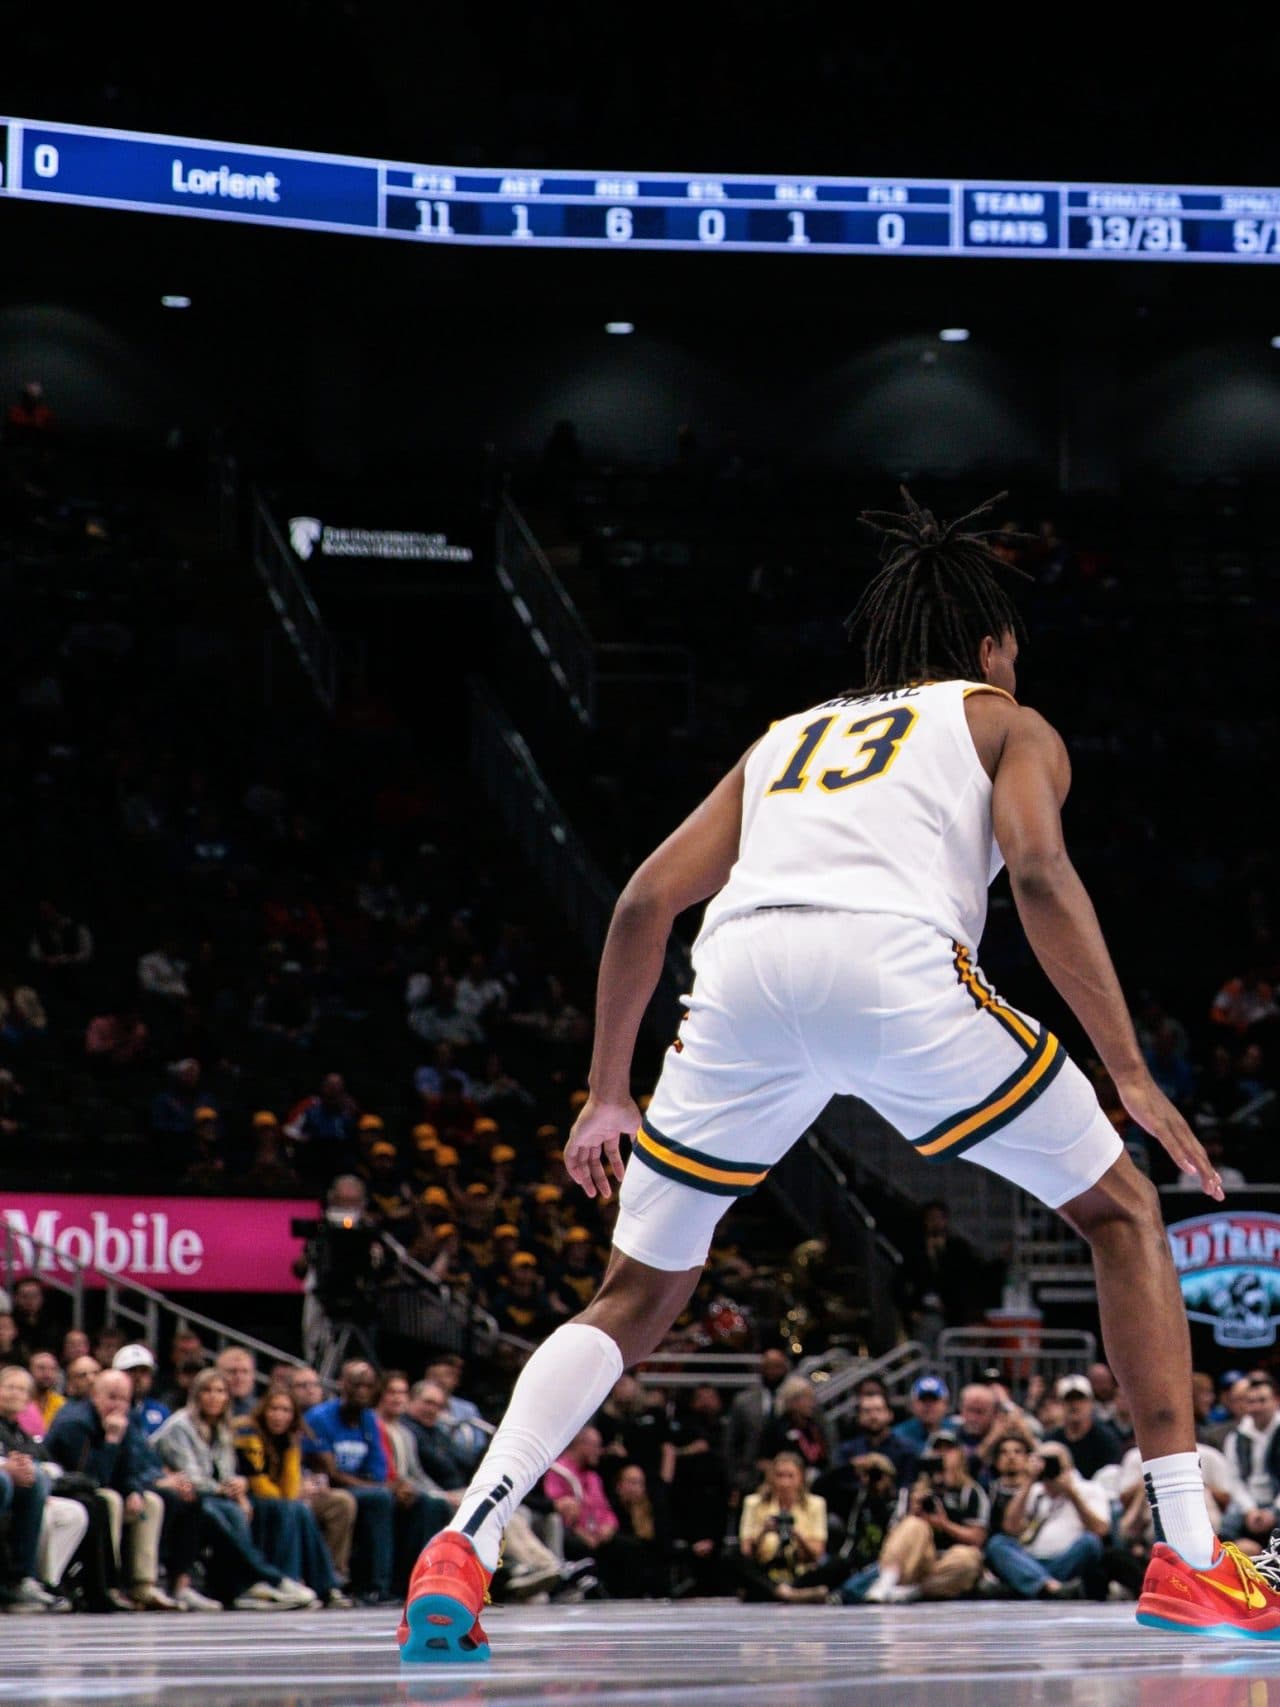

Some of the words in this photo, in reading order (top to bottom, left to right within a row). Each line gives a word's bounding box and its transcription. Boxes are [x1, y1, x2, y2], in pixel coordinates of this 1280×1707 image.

[34, 144, 59, 178] 0
[172, 159, 280, 202] Lorient
[416, 200, 454, 236] 11
[512, 204, 534, 239] 1
[606, 207, 633, 242] 6
[698, 209, 726, 245] 0
[788, 211, 810, 247] 1
[877, 213, 905, 249] 0
[972, 192, 1045, 215] TEAM
[969, 220, 1048, 245] STATS
[1086, 215, 1187, 253] 13/31
[764, 704, 920, 798] 13
[2, 1208, 204, 1275] Mobile
